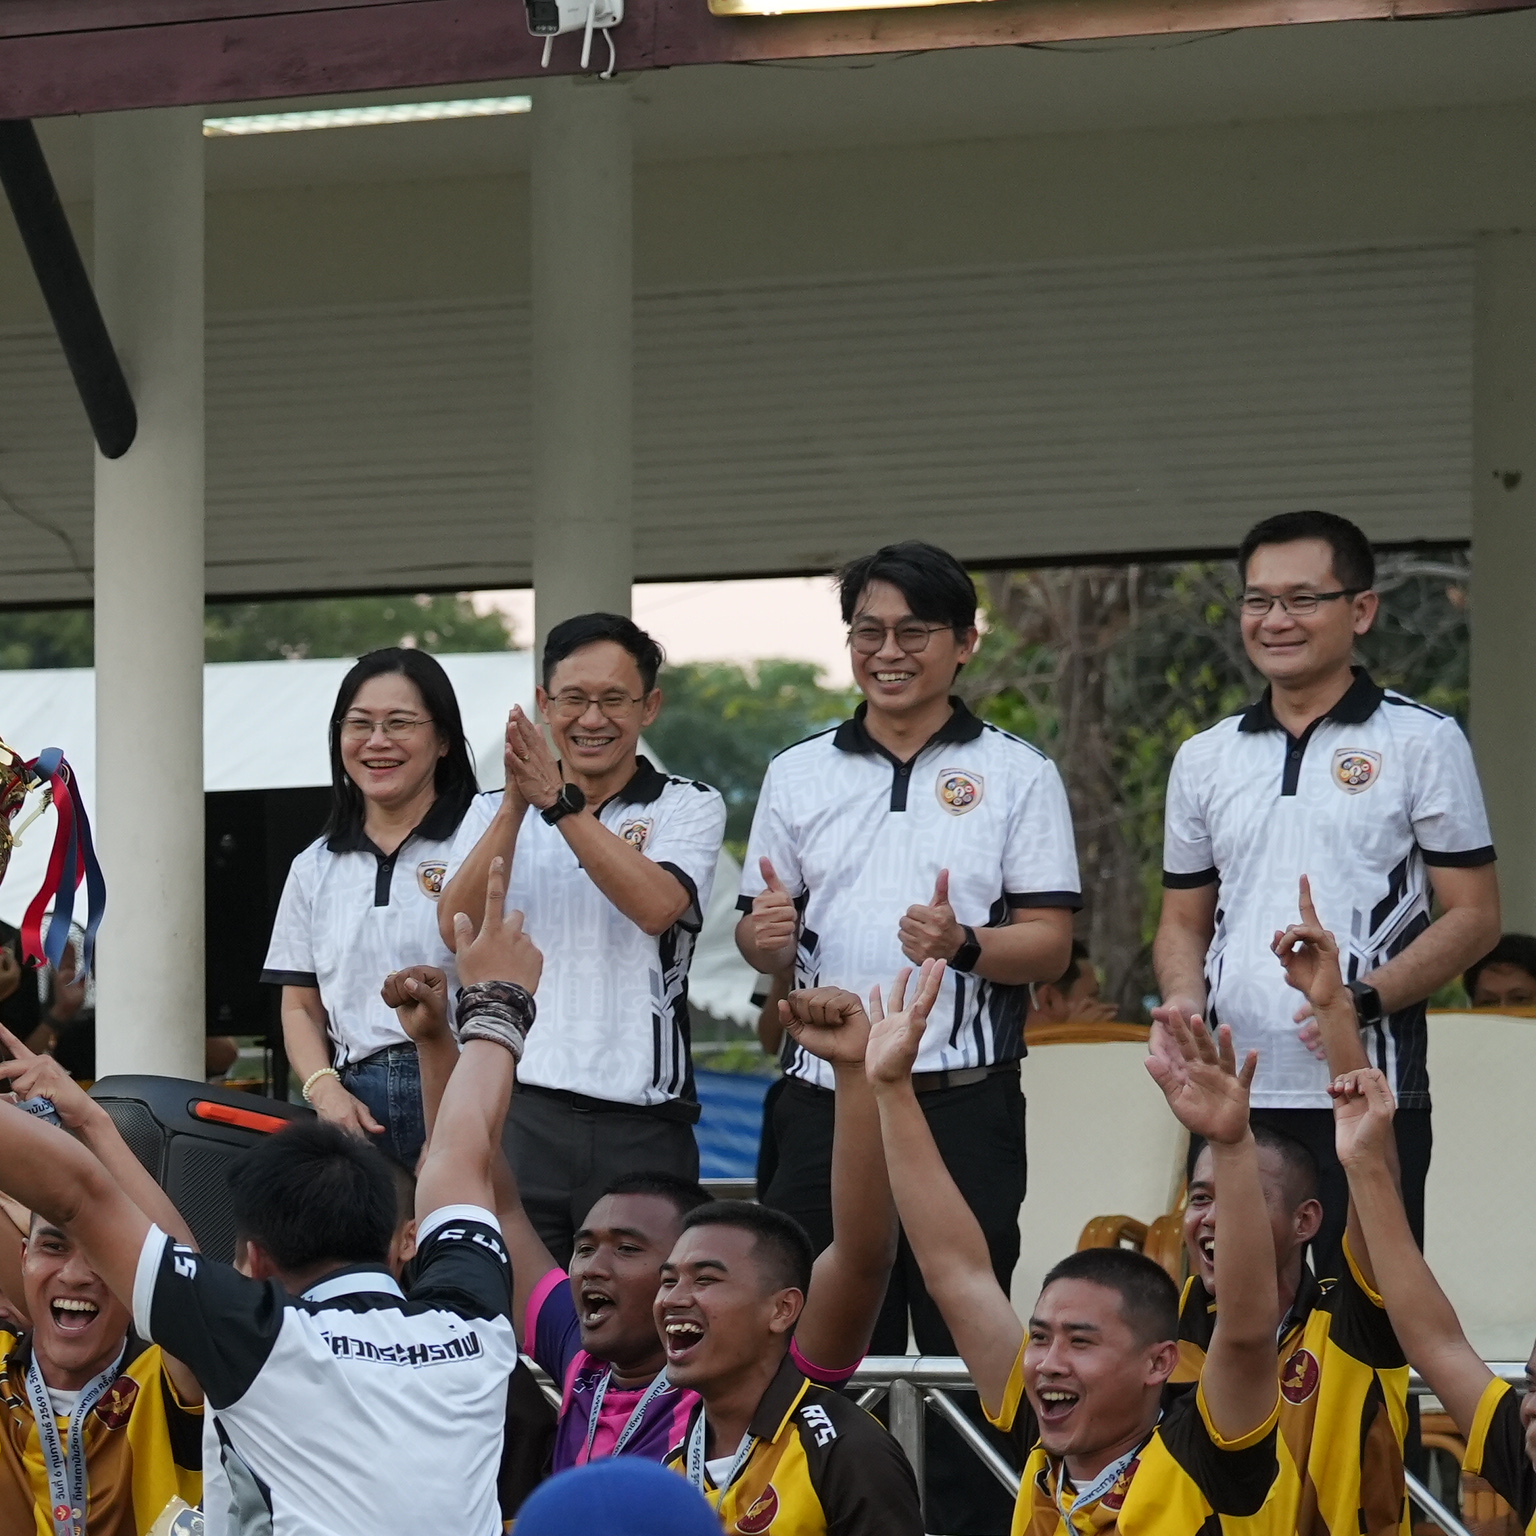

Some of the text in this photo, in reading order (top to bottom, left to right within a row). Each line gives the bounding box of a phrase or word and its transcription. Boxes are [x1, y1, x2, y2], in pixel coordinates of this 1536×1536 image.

[36, 1395, 50, 1420] 2569
[800, 1404, 839, 1448] RTS
[52, 1480, 67, 1501] วันที่
